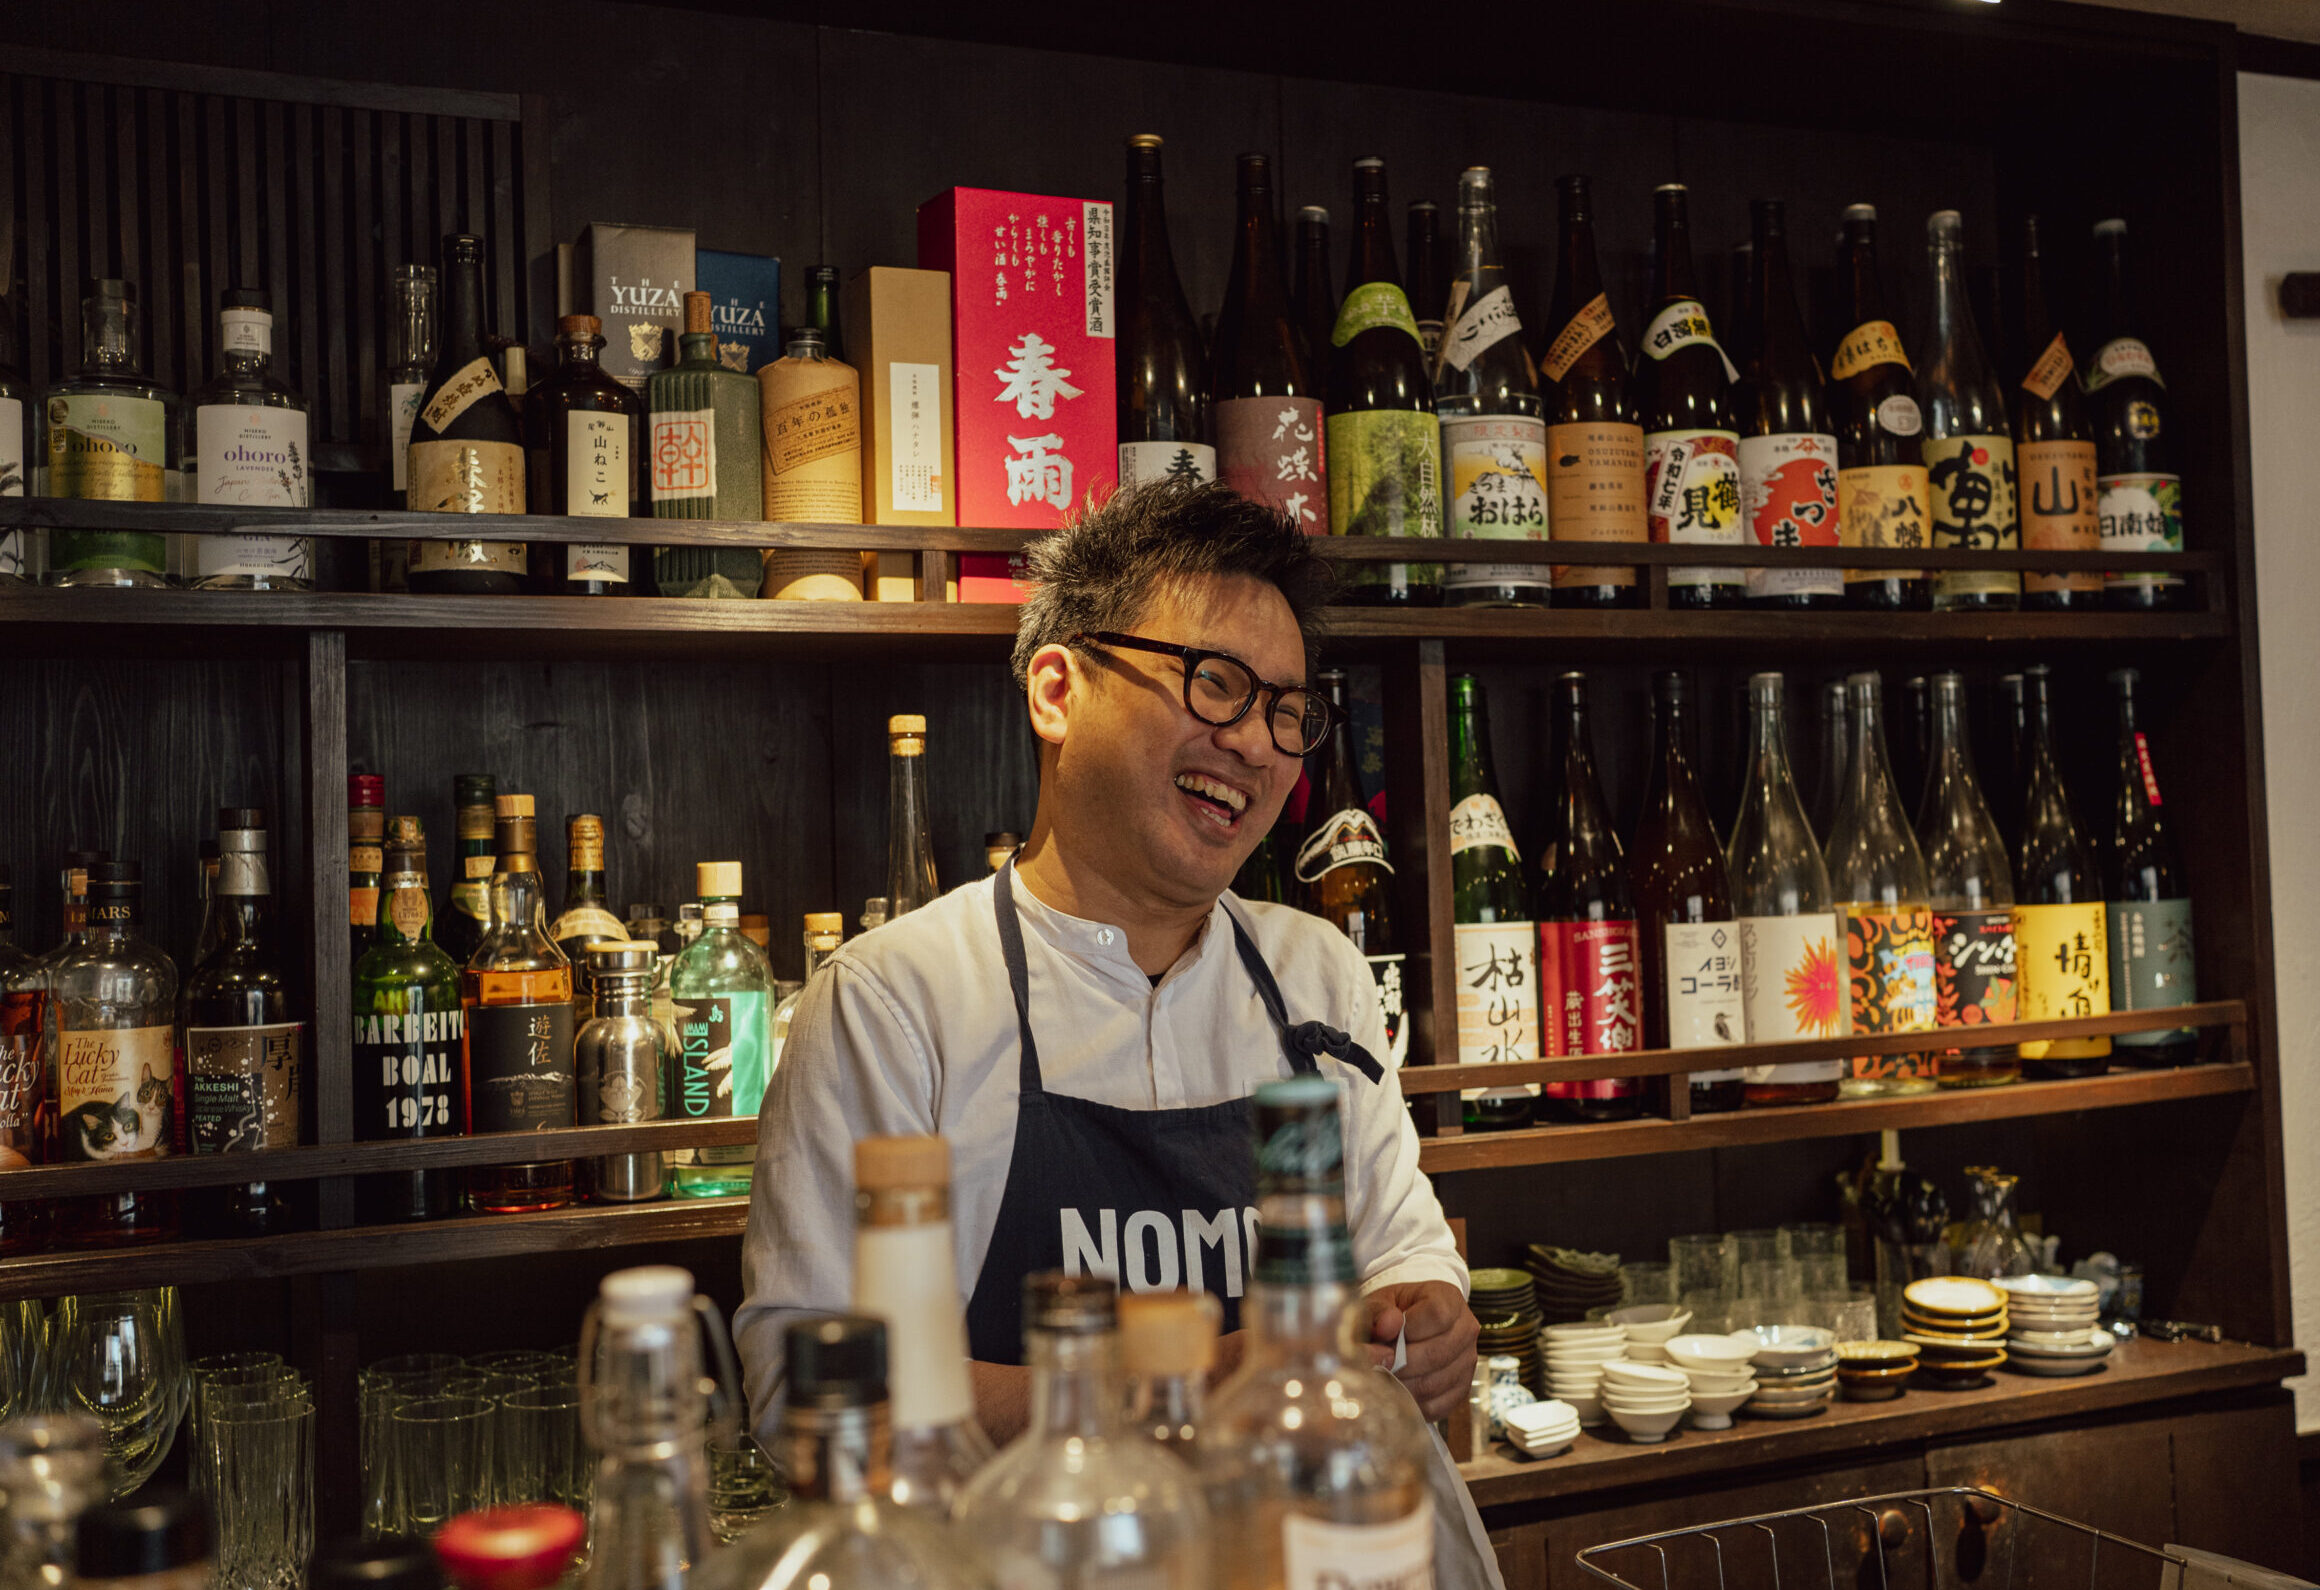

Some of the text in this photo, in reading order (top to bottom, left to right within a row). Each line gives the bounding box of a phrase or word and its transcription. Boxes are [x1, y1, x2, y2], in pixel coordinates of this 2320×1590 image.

[1087, 207, 1103, 333] 県知事賞受賞酒
[611, 286, 681, 307] YUZA
[611, 304, 681, 317] DISTILLERY
[776, 402, 851, 437] 百年の孤独
[994, 333, 1085, 511] 春雨
[72, 437, 138, 455] ohoro
[223, 445, 286, 464] ohoro
[594, 435, 608, 483] 山ねこ
[1417, 431, 1440, 538] 大自然林
[1469, 471, 1508, 495] さつま
[1469, 496, 1544, 526] おはら
[91, 905, 132, 920] ARS
[1465, 943, 1525, 1062] 枯山水
[0, 1044, 15, 1060] he
[75, 1037, 95, 1049] The
[528, 1014, 552, 1067] 遊佐
[63, 1043, 120, 1071] Lucky
[382, 1052, 452, 1087] BOAL
[682, 1021, 711, 1116] ISLAND
[66, 1063, 98, 1085] Cat
[194, 1083, 239, 1092] AKKESHI
[0, 1083, 24, 1111] at
[386, 1094, 450, 1129] 1978
